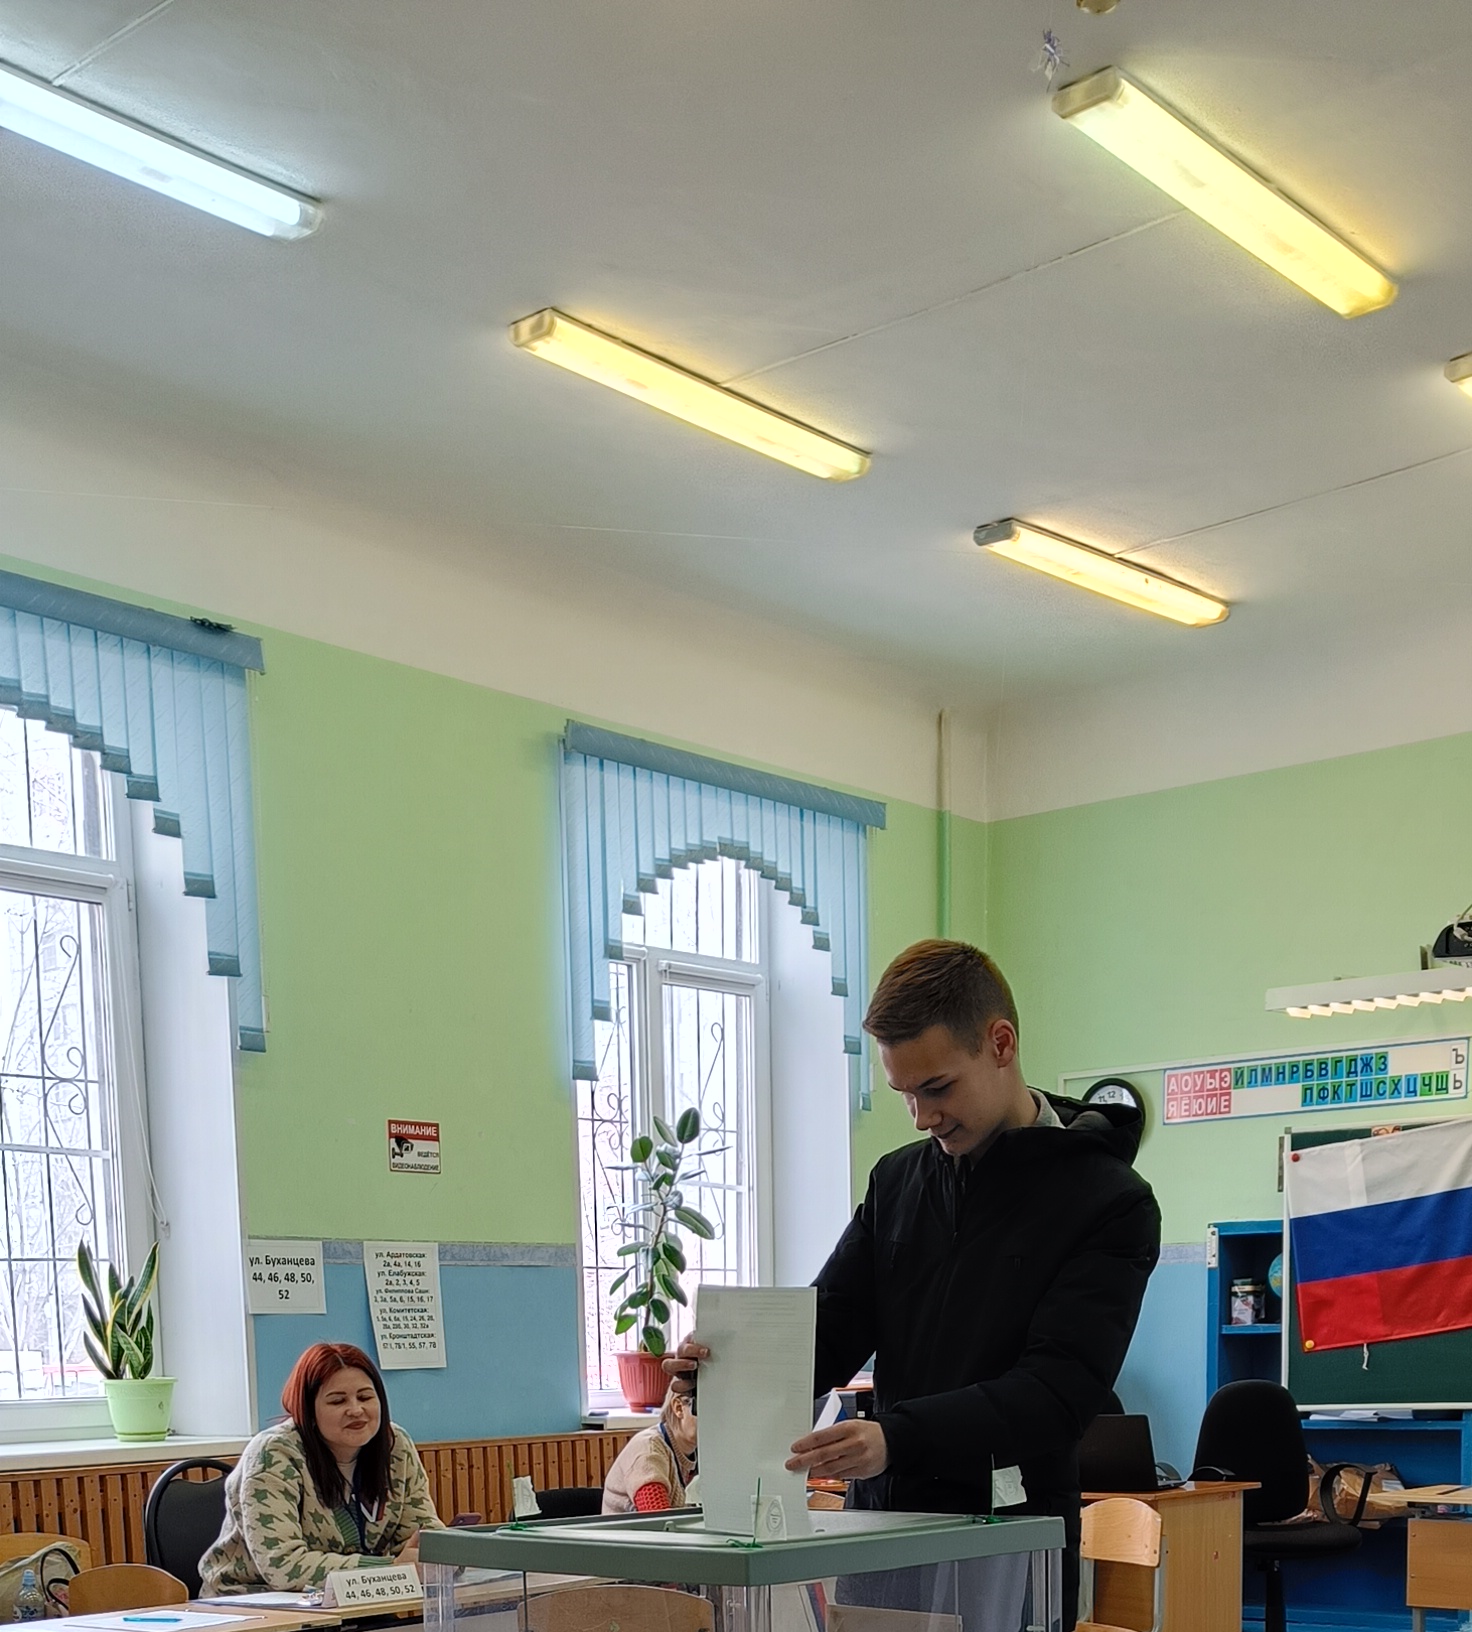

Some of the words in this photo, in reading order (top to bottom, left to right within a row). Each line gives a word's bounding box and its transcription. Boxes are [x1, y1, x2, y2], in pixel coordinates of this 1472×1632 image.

[1452, 1048, 1465, 1064] Ъ
[1107, 1090, 1116, 1098] 12
[390, 1123, 437, 1136] ВНИМАНИЕ
[249, 1257, 263, 1267] ул.
[265, 1255, 315, 1267] Буханцева
[252, 1272, 265, 1284] 44,
[267, 1272, 281, 1284] 46,
[284, 1272, 298, 1284] 48,
[301, 1272, 315, 1284] 50,
[278, 1289, 290, 1300] 52
[346, 1579, 359, 1587] ул.
[361, 1573, 407, 1585] Буханцева
[346, 1591, 359, 1600] 44,
[361, 1589, 374, 1598] 46,
[375, 1587, 389, 1596] 48,
[390, 1586, 404, 1595] 50,
[404, 1584, 415, 1593] 52
